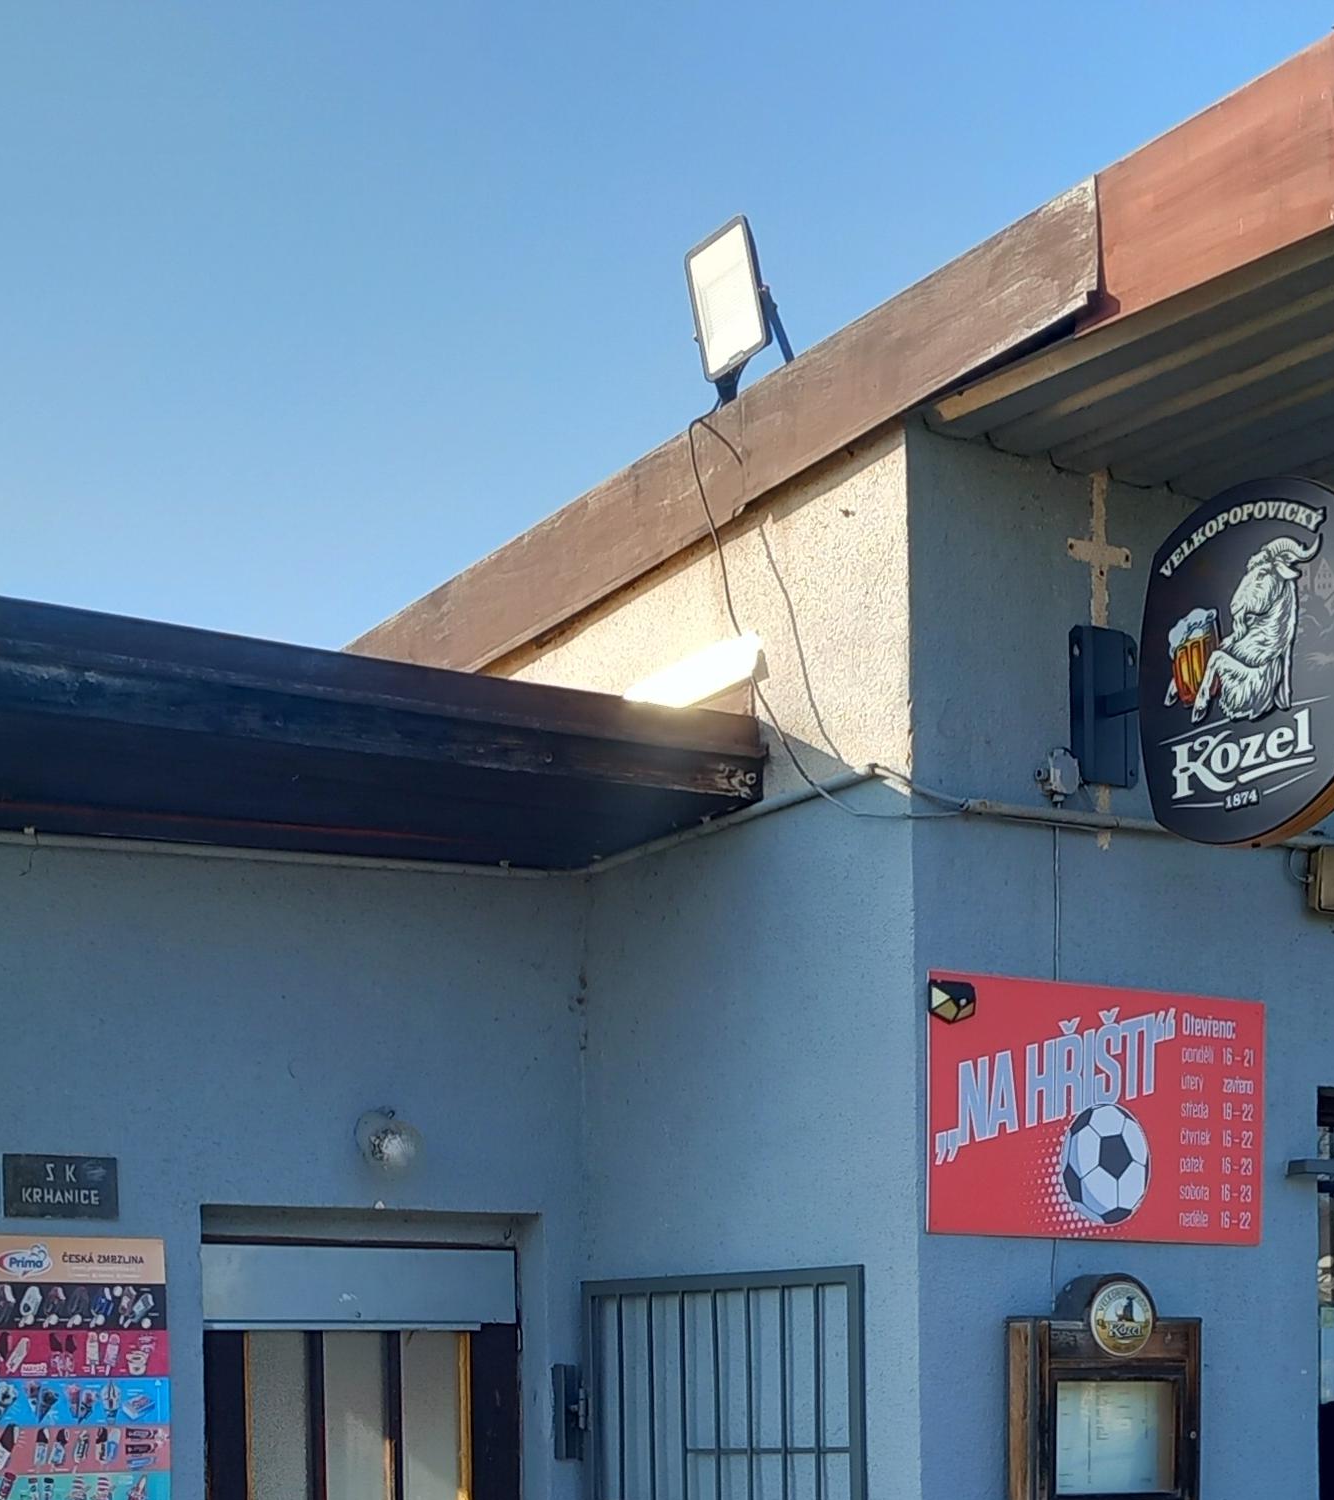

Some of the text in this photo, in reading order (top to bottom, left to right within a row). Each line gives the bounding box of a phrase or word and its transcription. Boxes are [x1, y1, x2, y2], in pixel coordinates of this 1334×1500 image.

[1159, 501, 1324, 578] VELKOPOPOVICKÝ
[1172, 708, 1315, 799] Kozel
[1224, 790, 1258, 810] 1874
[1182, 1012, 1236, 1040] Otevřeno:
[1222, 1048, 1232, 1066] 16
[1244, 1049, 1254, 1067] 21
[1242, 1104, 1254, 1121] 22
[1223, 1130, 1232, 1147] 16
[1241, 1131, 1253, 1148] 22
[66, 1164, 77, 1183] K
[1222, 1157, 1231, 1174] 16
[1240, 1158, 1253, 1176] 23
[22, 1187, 100, 1205] KRHANICE
[1179, 1183, 1209, 1200] sobota
[1221, 1184, 1231, 1201] 16
[1240, 1185, 1252, 1202] 23
[1220, 1212, 1230, 1229] 16
[1240, 1212, 1251, 1230] 22
[9, 1252, 144, 1268] Prima ČESKÁ ZMRZLINA
